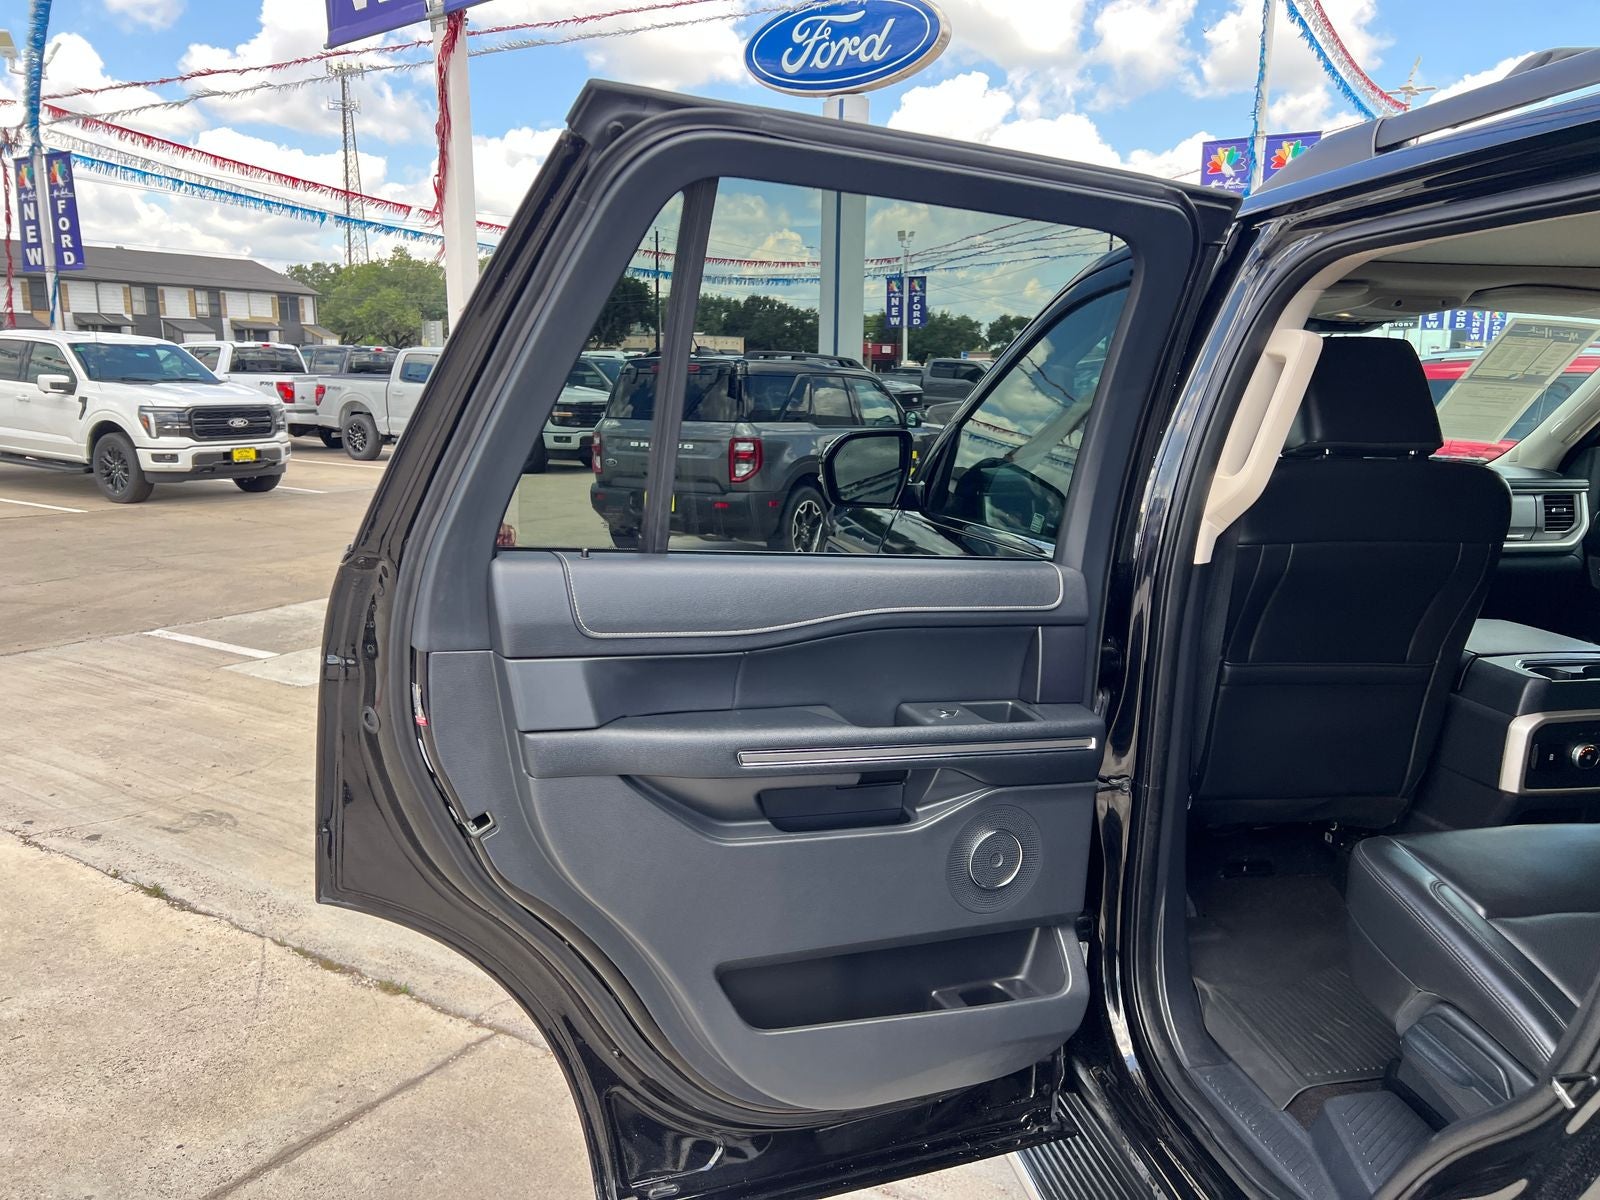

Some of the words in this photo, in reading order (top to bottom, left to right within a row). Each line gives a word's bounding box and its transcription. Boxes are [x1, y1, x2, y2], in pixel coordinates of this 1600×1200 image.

[781, 10, 896, 74] Ford
[23, 202, 43, 266] NEW
[57, 200, 75, 265] FORD
[889, 297, 901, 326] NEW
[912, 296, 921, 325] FORD
[1426, 313, 1440, 329] EW
[1455, 310, 1466, 329] ORD
[1470, 321, 1481, 340] NEW
[630, 441, 694, 449] BRO
